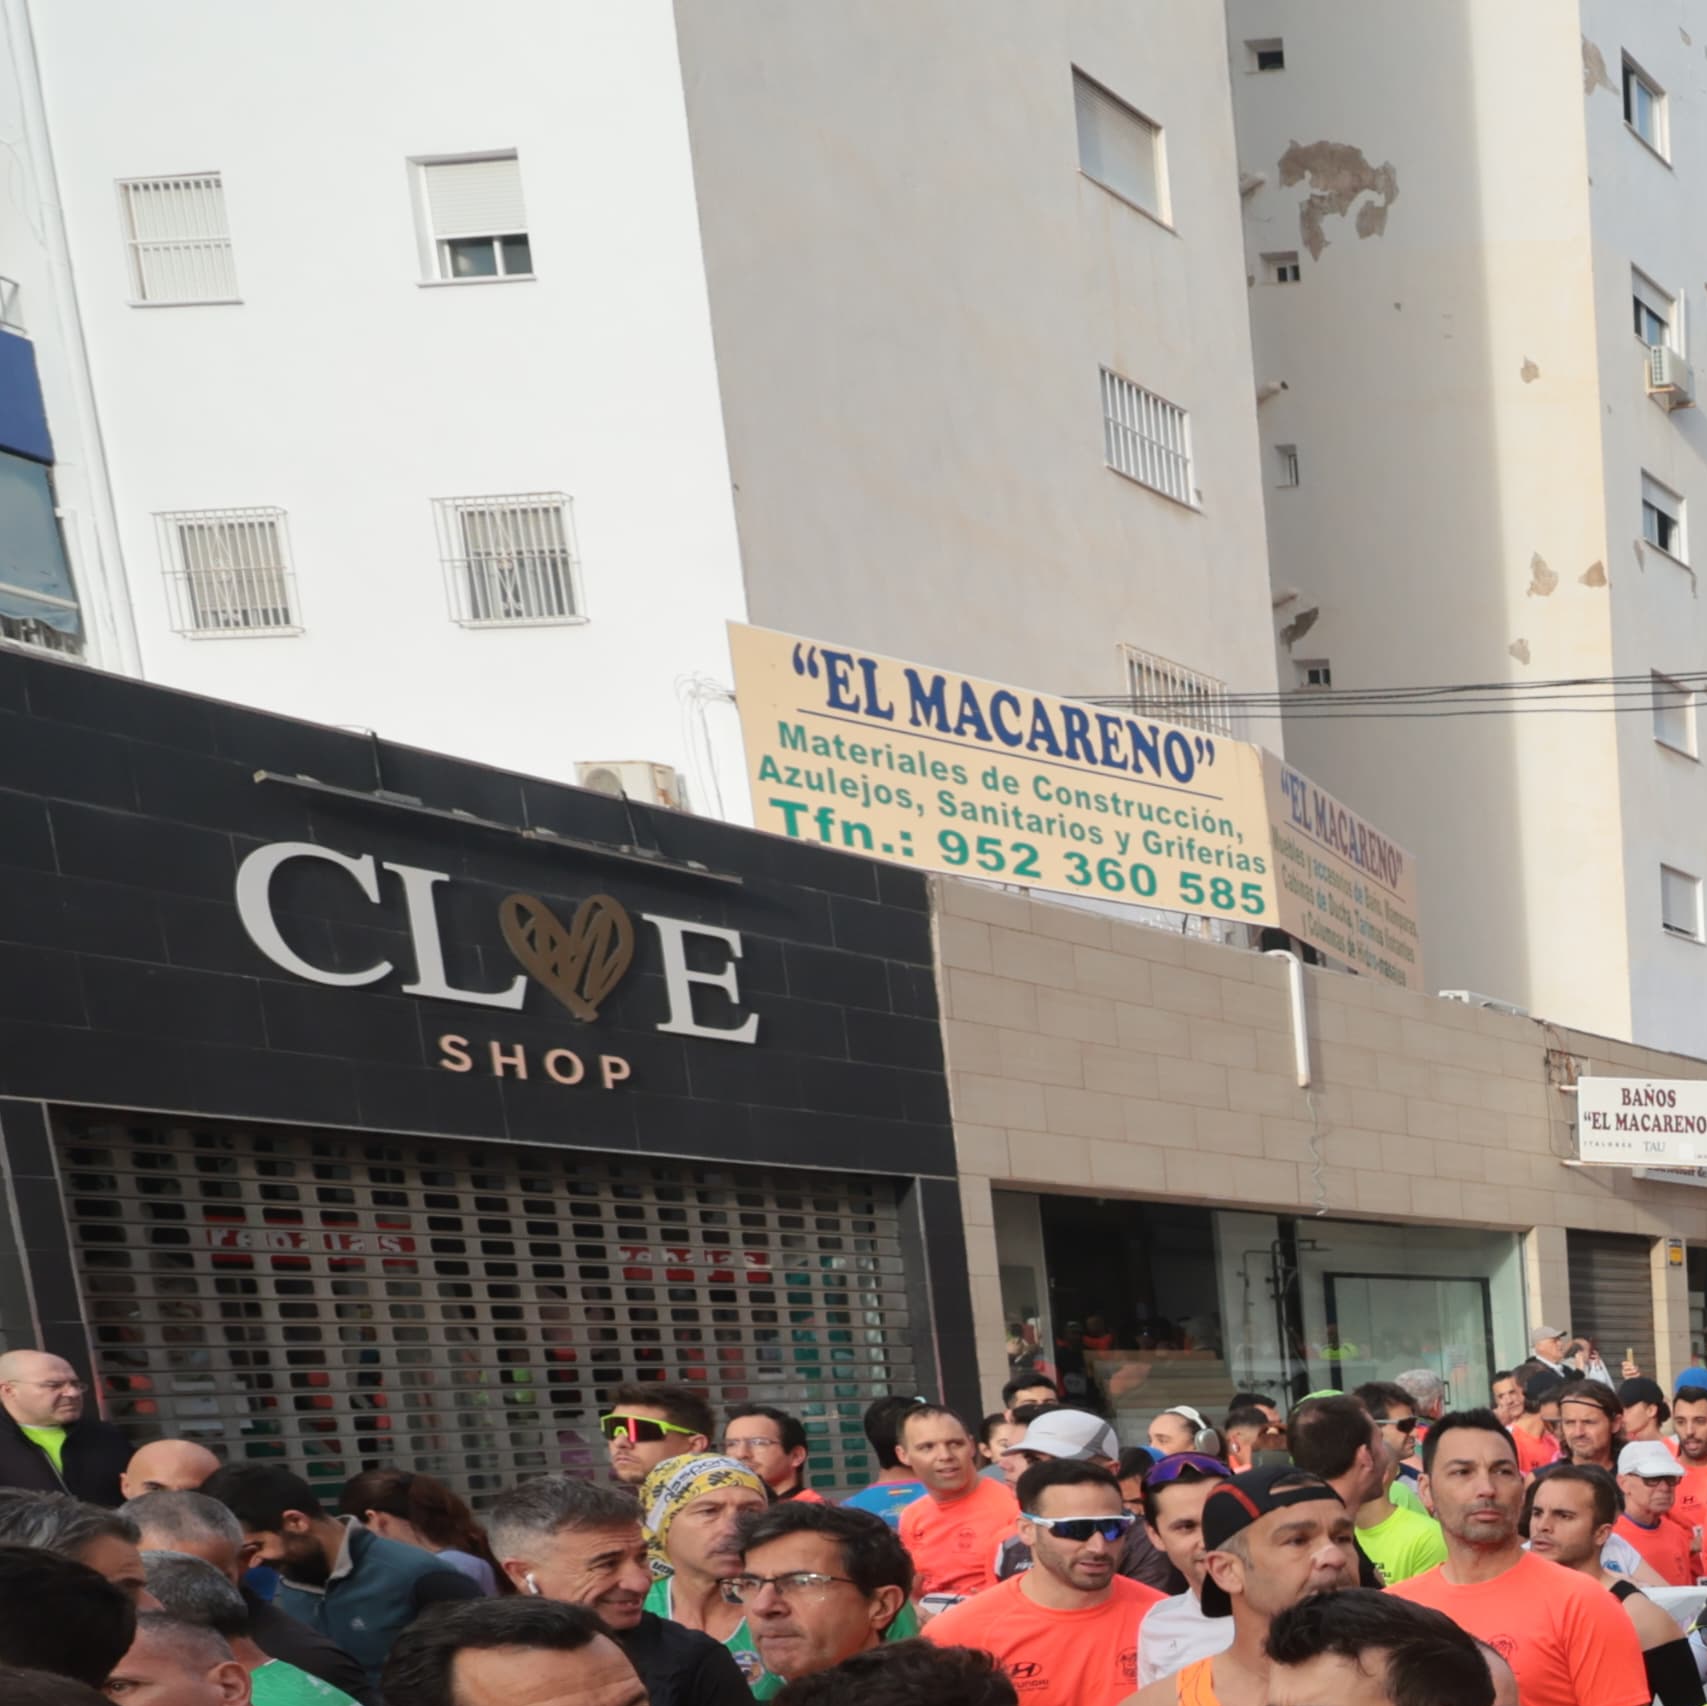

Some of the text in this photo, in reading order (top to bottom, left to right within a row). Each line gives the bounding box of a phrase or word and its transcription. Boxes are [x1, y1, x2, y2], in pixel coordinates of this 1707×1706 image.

[757, 754, 1267, 874] Azulejos, Sanitarios y Griferías
[777, 720, 1244, 844] Materiales de Construcción,
[768, 796, 1266, 916] Tfn.: 952 360 585
[438, 1033, 632, 1091] SHOP
[1620, 1083, 1677, 1108] BAÑOS
[1642, 1140, 1666, 1154] TAU
